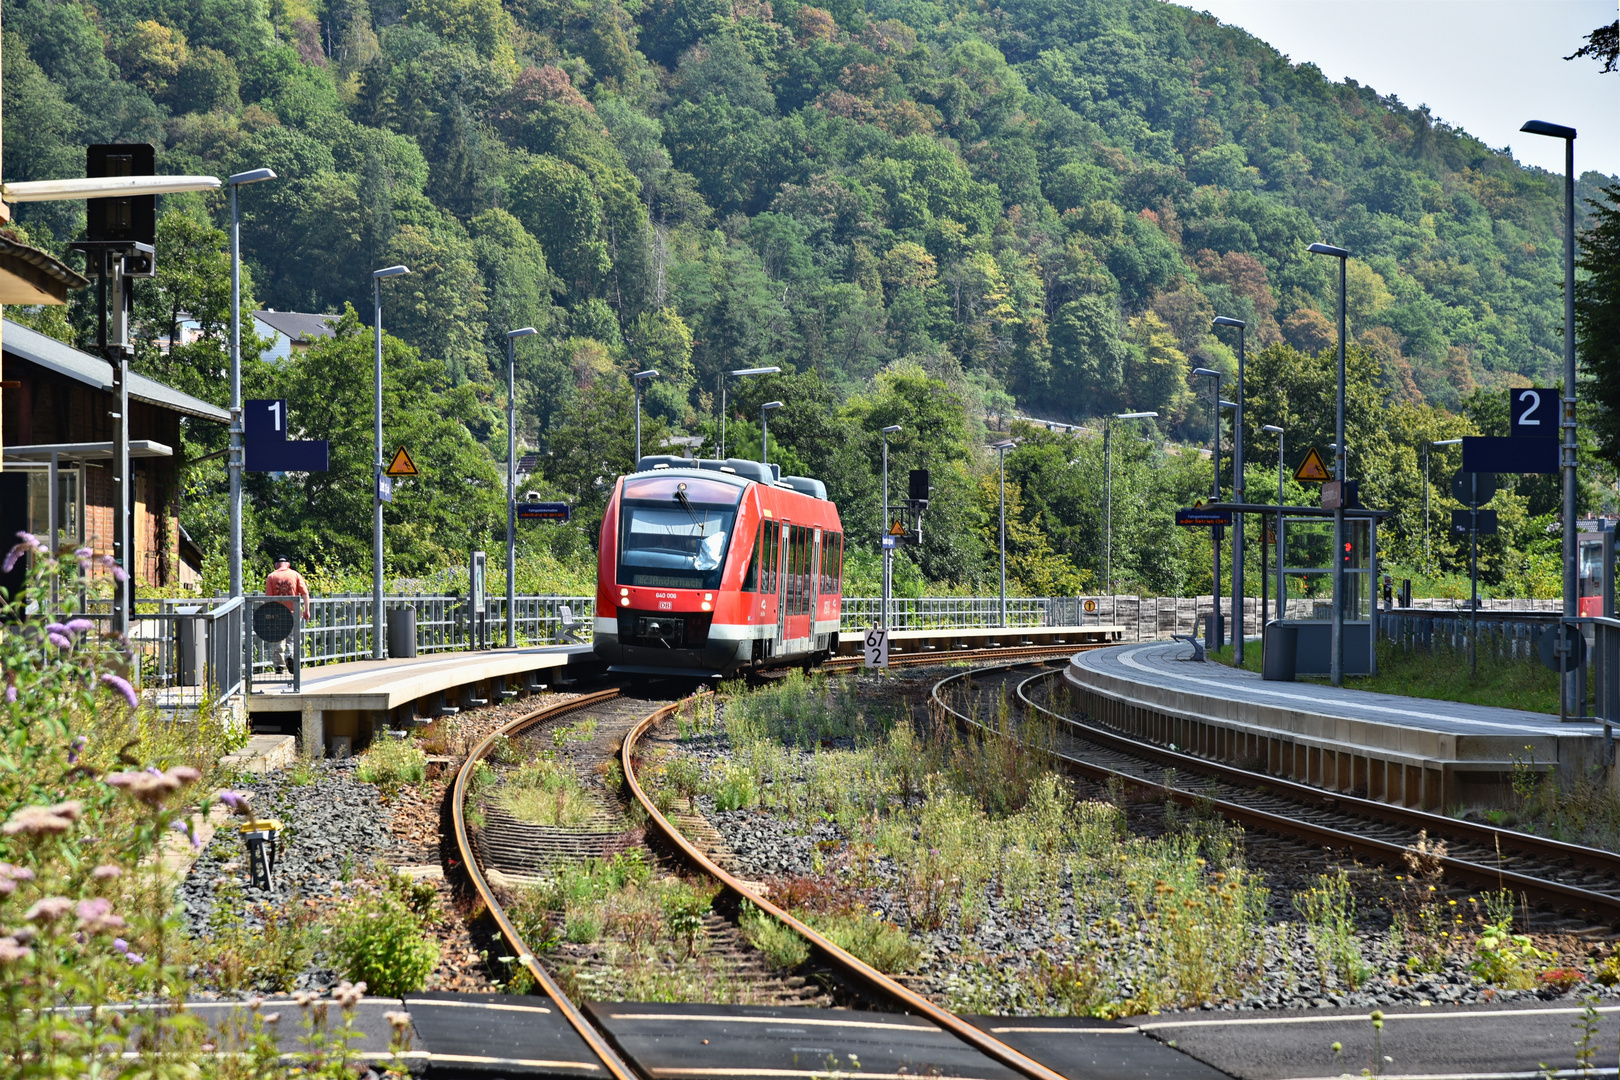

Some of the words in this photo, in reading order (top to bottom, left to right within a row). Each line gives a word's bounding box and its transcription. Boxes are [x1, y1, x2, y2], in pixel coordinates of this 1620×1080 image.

[268, 401, 281, 431] 1
[1518, 390, 1541, 425] 2
[659, 601, 672, 610] DB
[866, 630, 886, 647] 67
[872, 648, 882, 664] 2
